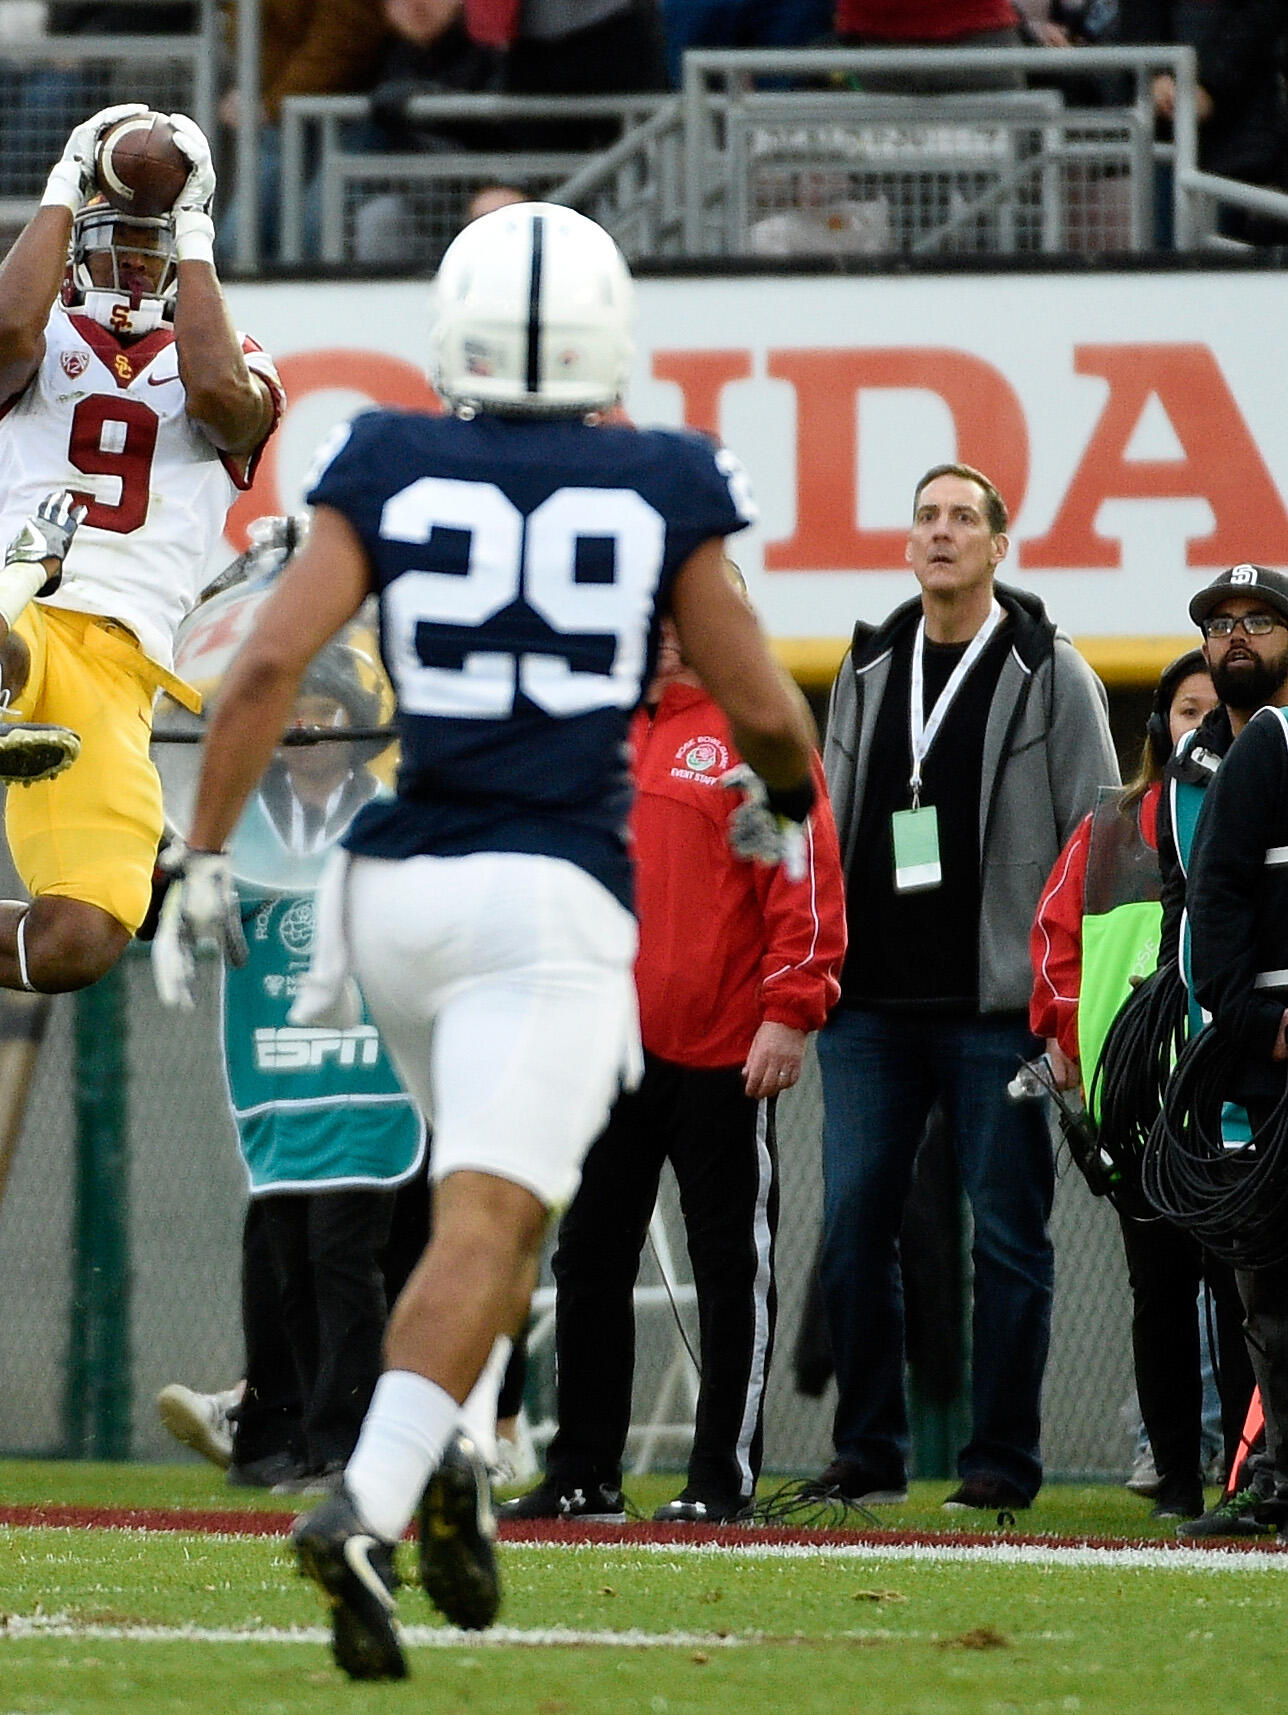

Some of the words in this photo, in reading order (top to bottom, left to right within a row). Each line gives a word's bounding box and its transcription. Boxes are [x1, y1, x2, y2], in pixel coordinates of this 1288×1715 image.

[114, 354, 132, 379] SC
[67, 392, 159, 535] 9
[379, 476, 666, 720] 29
[675, 738, 696, 759] ROSE
[697, 735, 722, 747] BOWL
[670, 767, 695, 780] EVENT
[255, 1024, 380, 1069] ESPN
